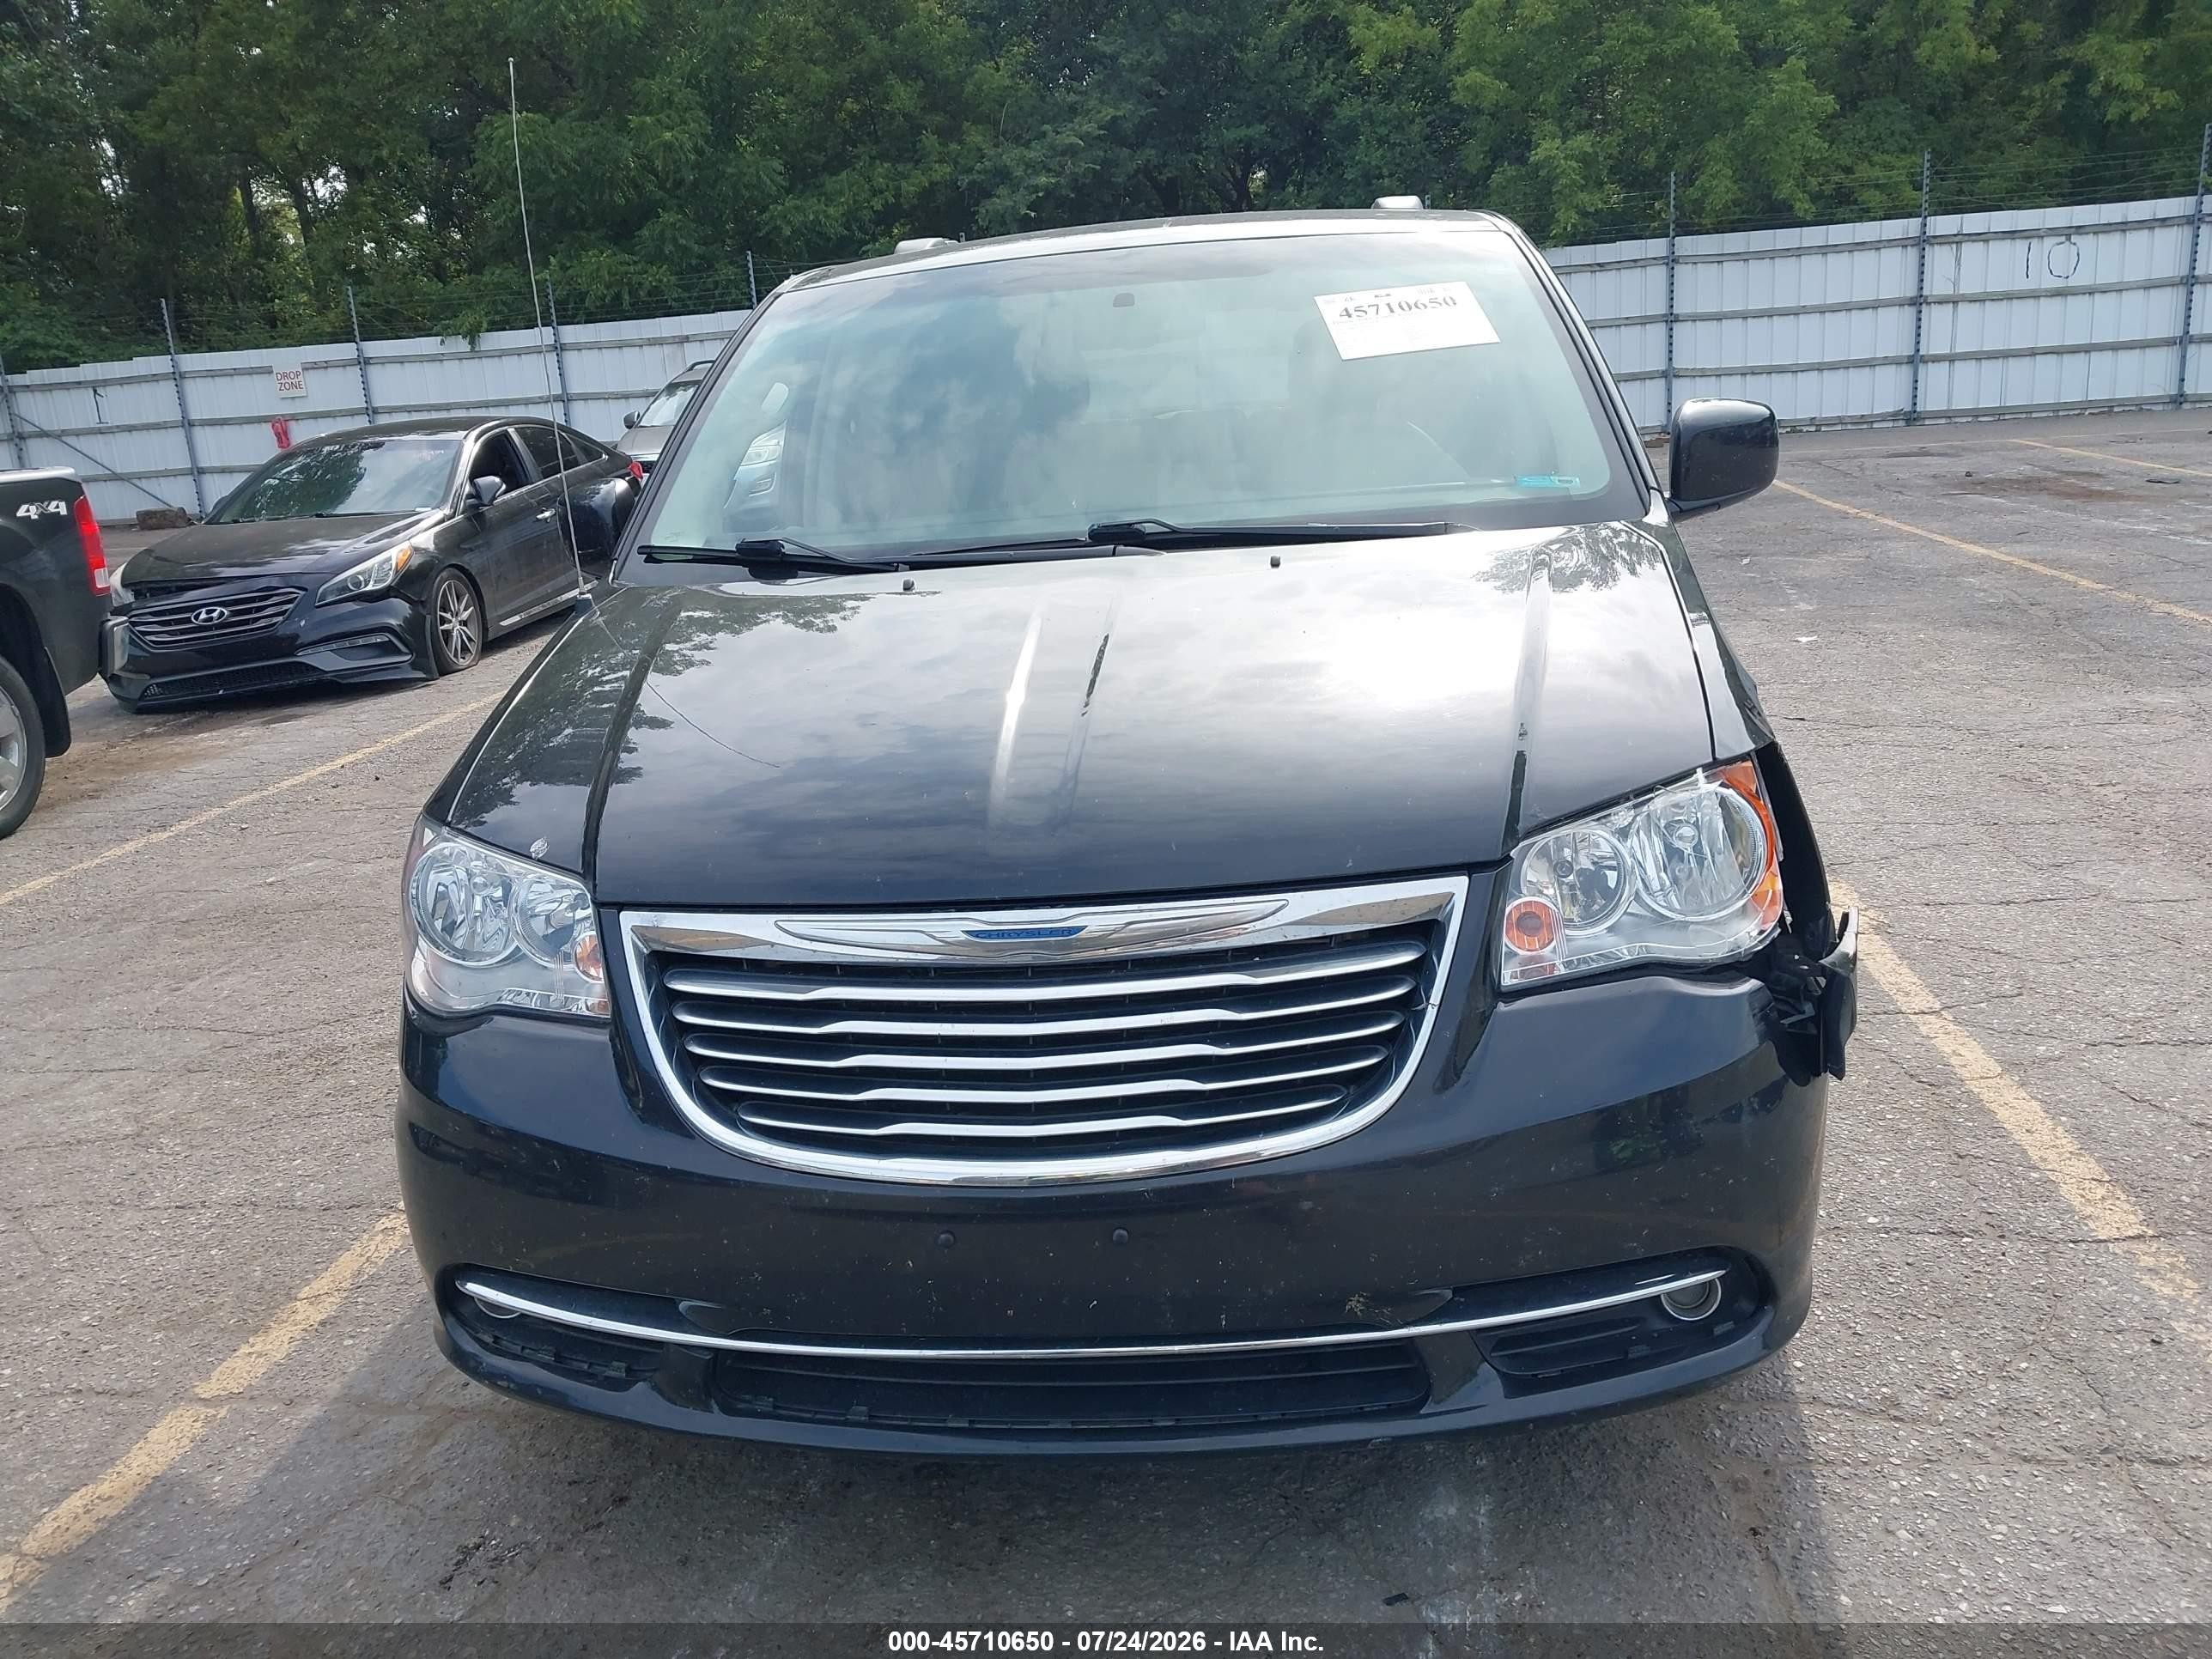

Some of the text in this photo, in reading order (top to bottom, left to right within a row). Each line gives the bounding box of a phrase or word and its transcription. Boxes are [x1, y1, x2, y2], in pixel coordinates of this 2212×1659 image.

[2026, 236, 2080, 279] 10
[1339, 295, 1457, 319] 45710650
[275, 370, 301, 381] DROP
[277, 380, 304, 392] ZONE
[976, 928, 1073, 939] CHRYSLER
